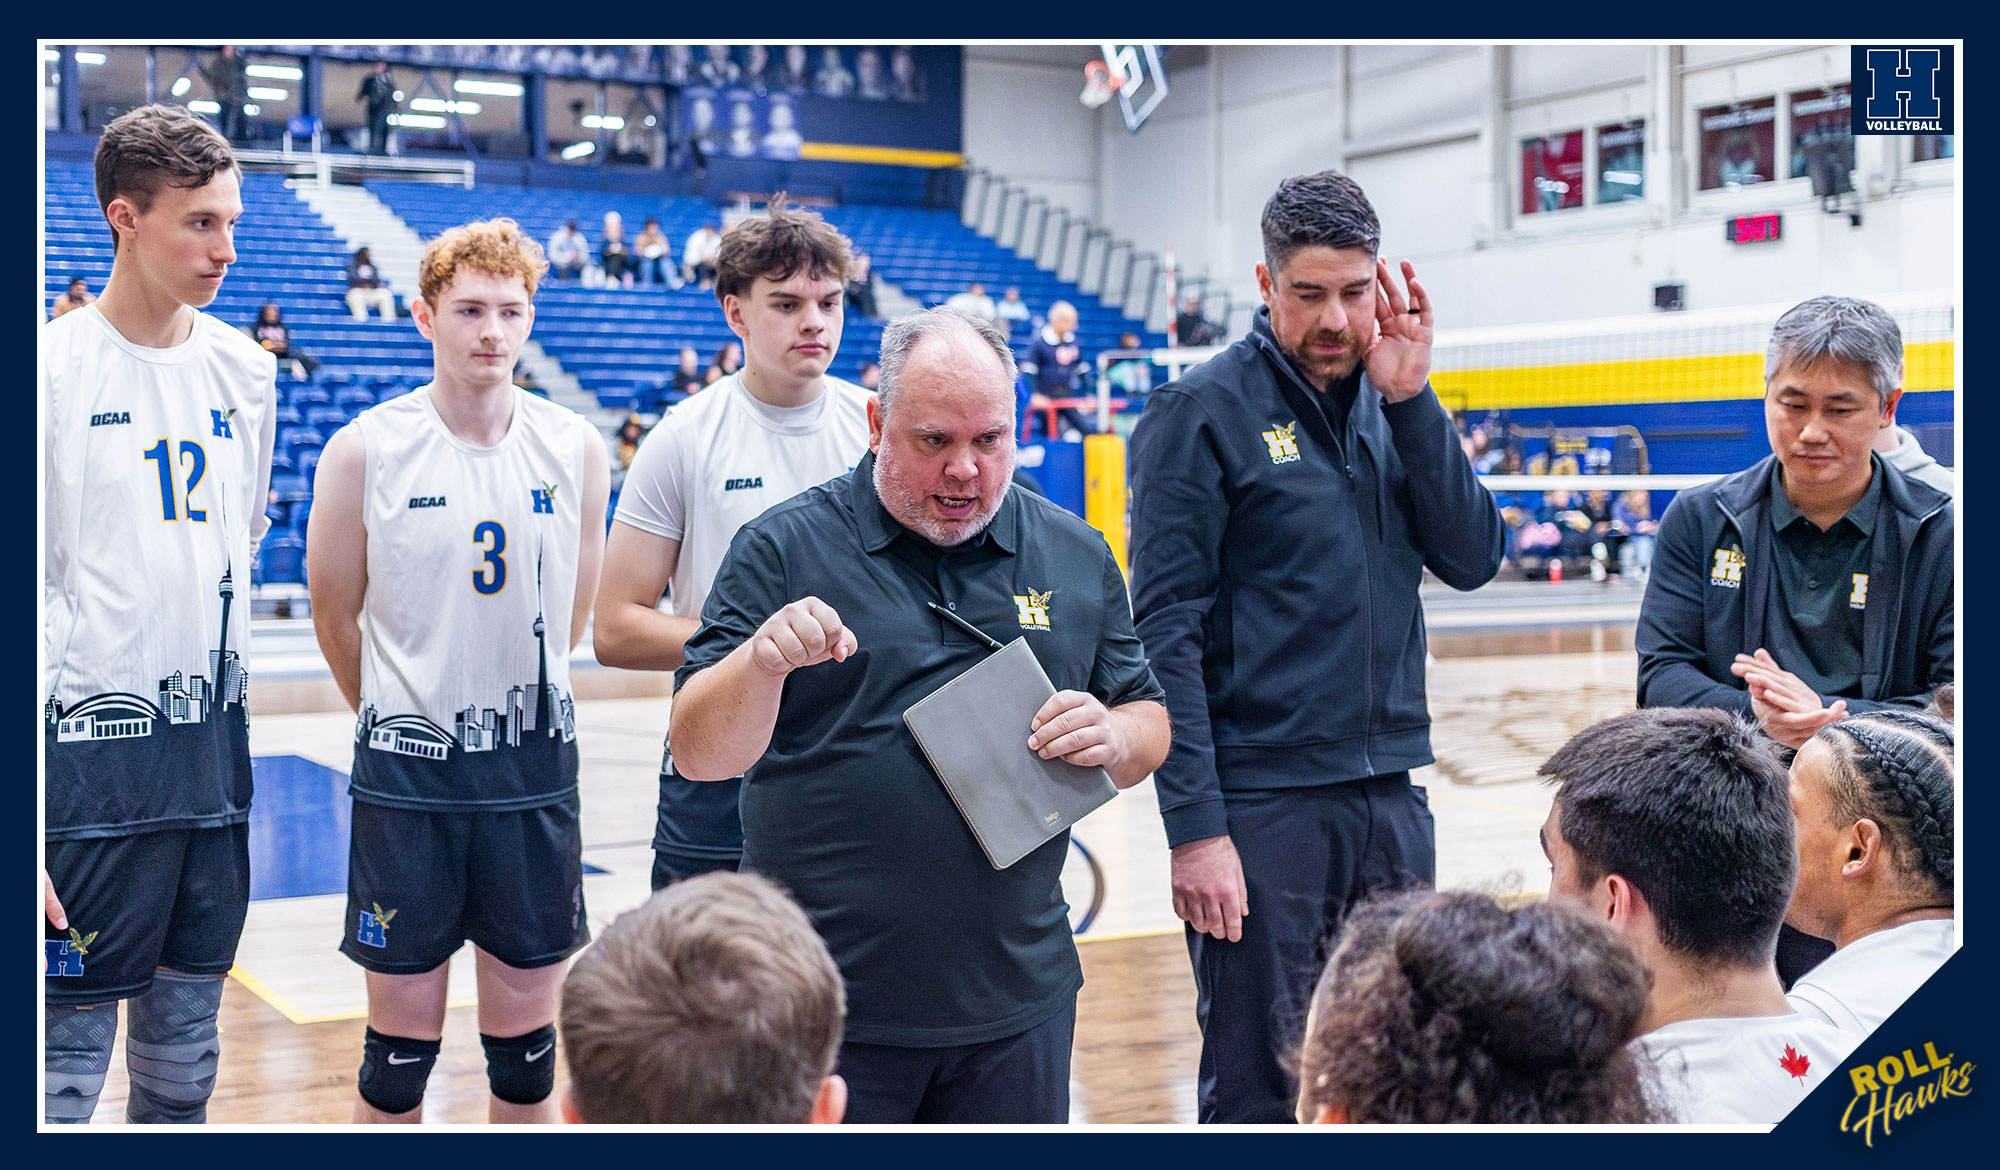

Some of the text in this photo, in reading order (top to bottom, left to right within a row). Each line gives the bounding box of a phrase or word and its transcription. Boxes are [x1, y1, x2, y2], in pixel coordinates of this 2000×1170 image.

[90, 411, 131, 427] OCAA
[210, 408, 233, 440] H
[1262, 430, 1299, 458] H
[1272, 453, 1301, 465] COACH
[142, 437, 208, 524] 12
[725, 477, 763, 491] OCAA
[408, 496, 447, 509] OCAA
[530, 489, 554, 514] H
[472, 519, 508, 597] 3
[1711, 548, 1742, 582] H
[1710, 577, 1741, 589] COACH
[1013, 595, 1051, 626] H
[357, 909, 387, 949] H
